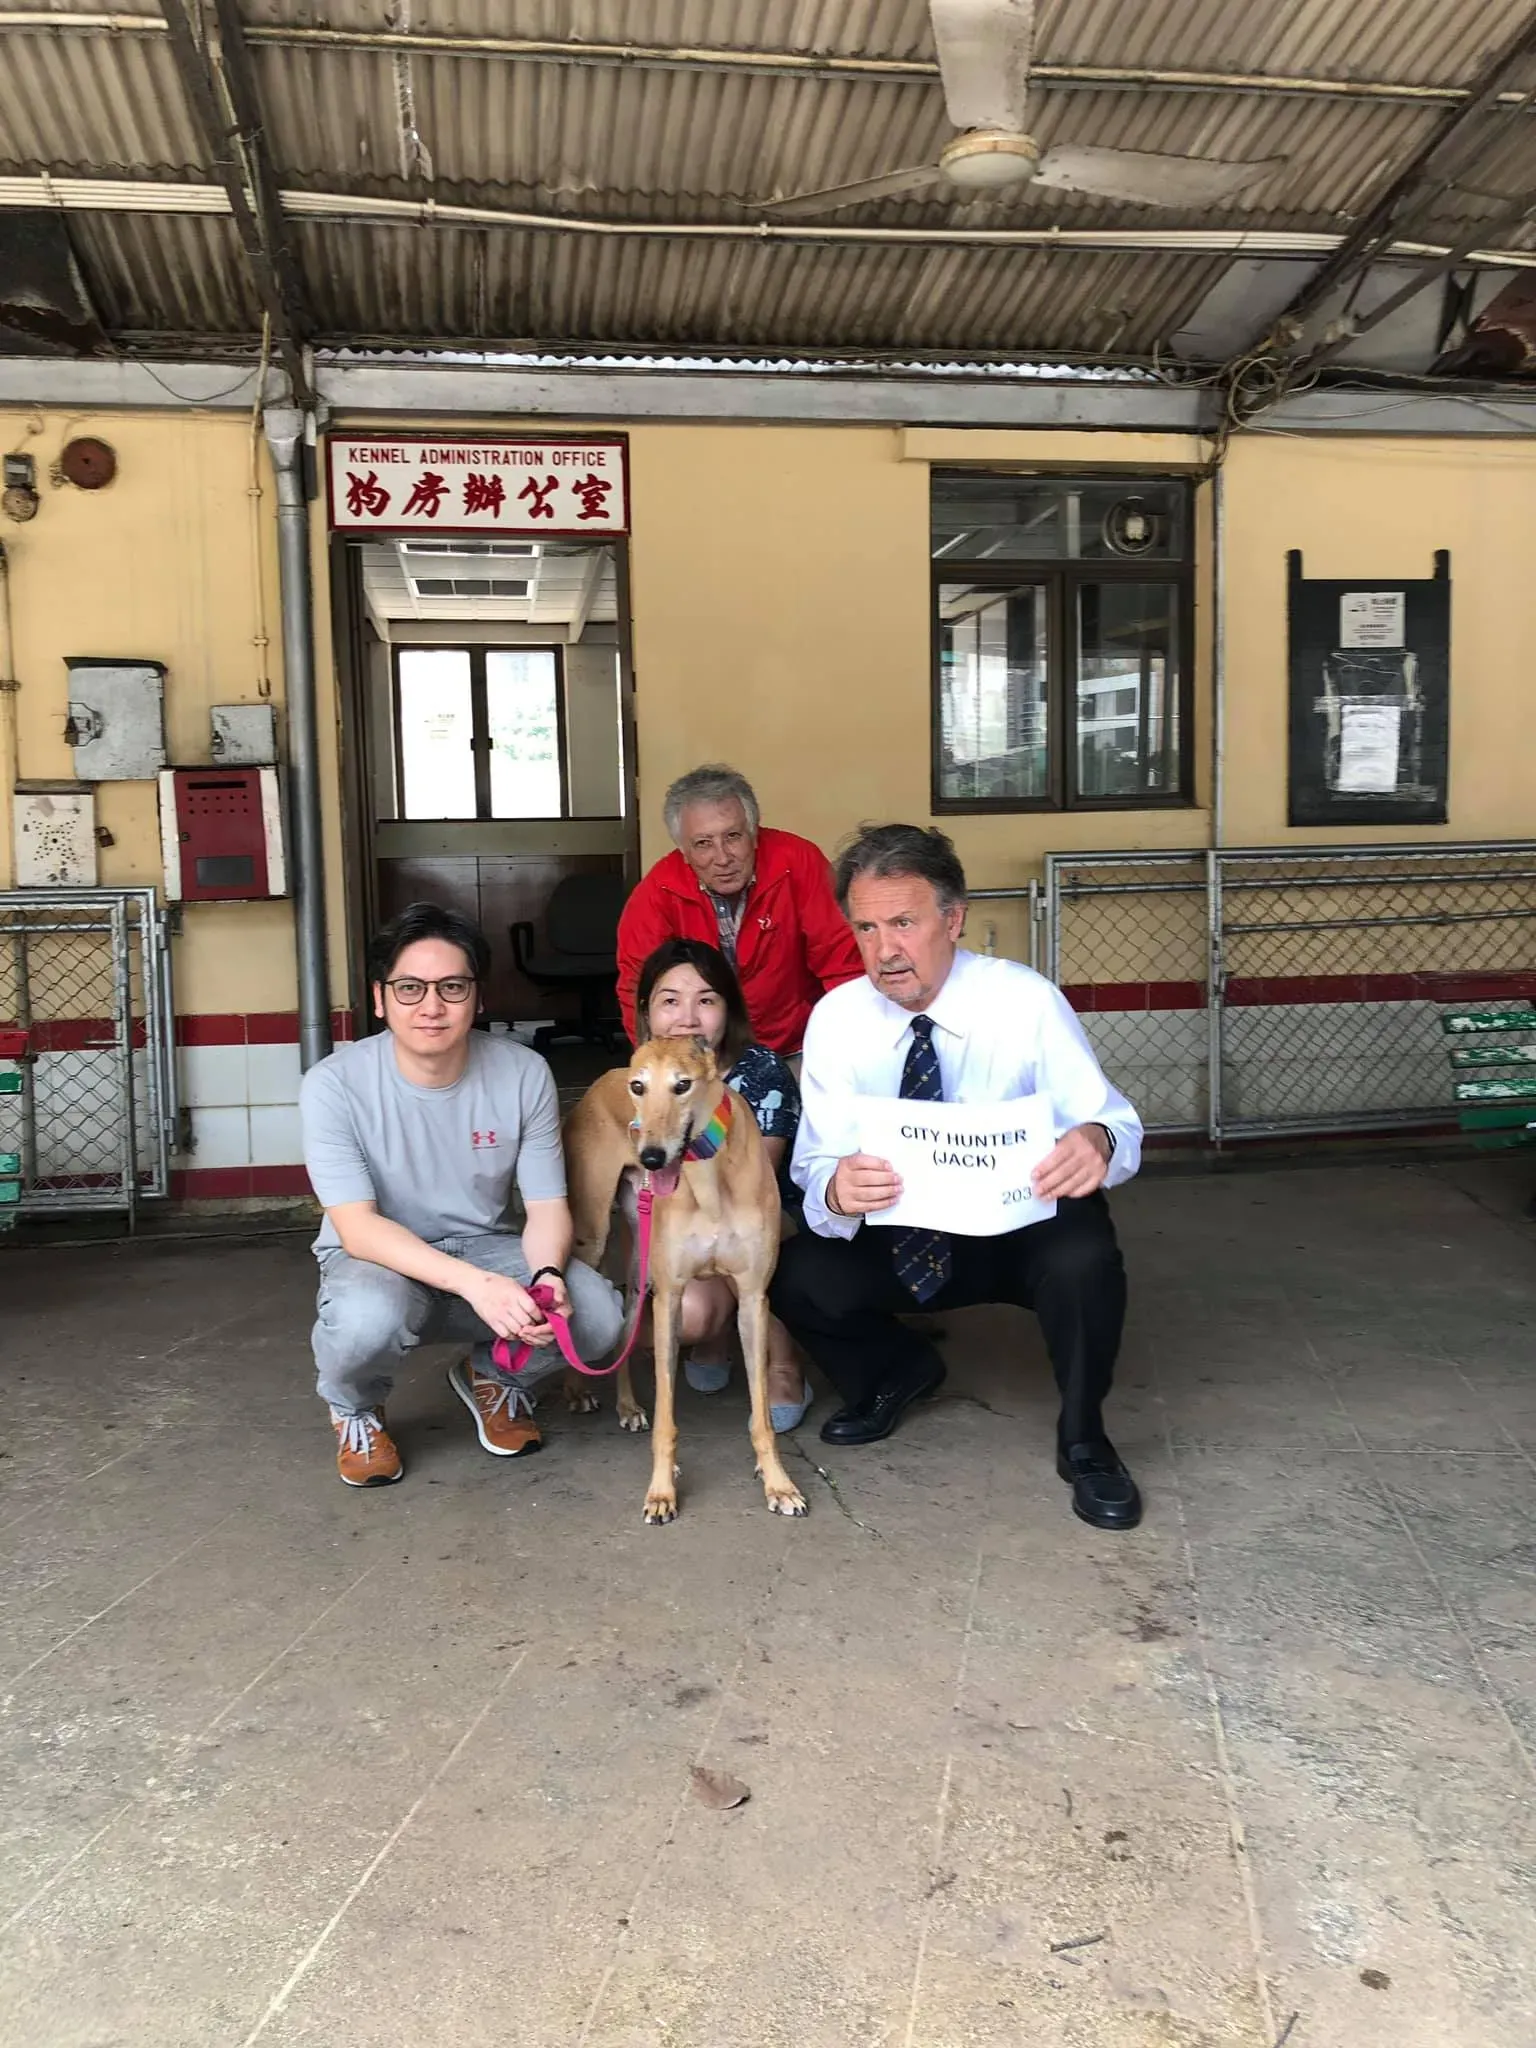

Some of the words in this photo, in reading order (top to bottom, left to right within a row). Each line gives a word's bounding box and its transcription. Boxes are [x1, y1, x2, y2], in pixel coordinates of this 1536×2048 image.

[348, 448, 411, 464] KENNEL
[420, 449, 544, 466] ADMINISTRATION
[552, 451, 607, 467] OFFICE
[345, 470, 613, 520] 狗房辦公室
[900, 1125, 940, 1143] CITY
[946, 1129, 1027, 1148] HUNTER
[932, 1150, 996, 1170] (JACK)
